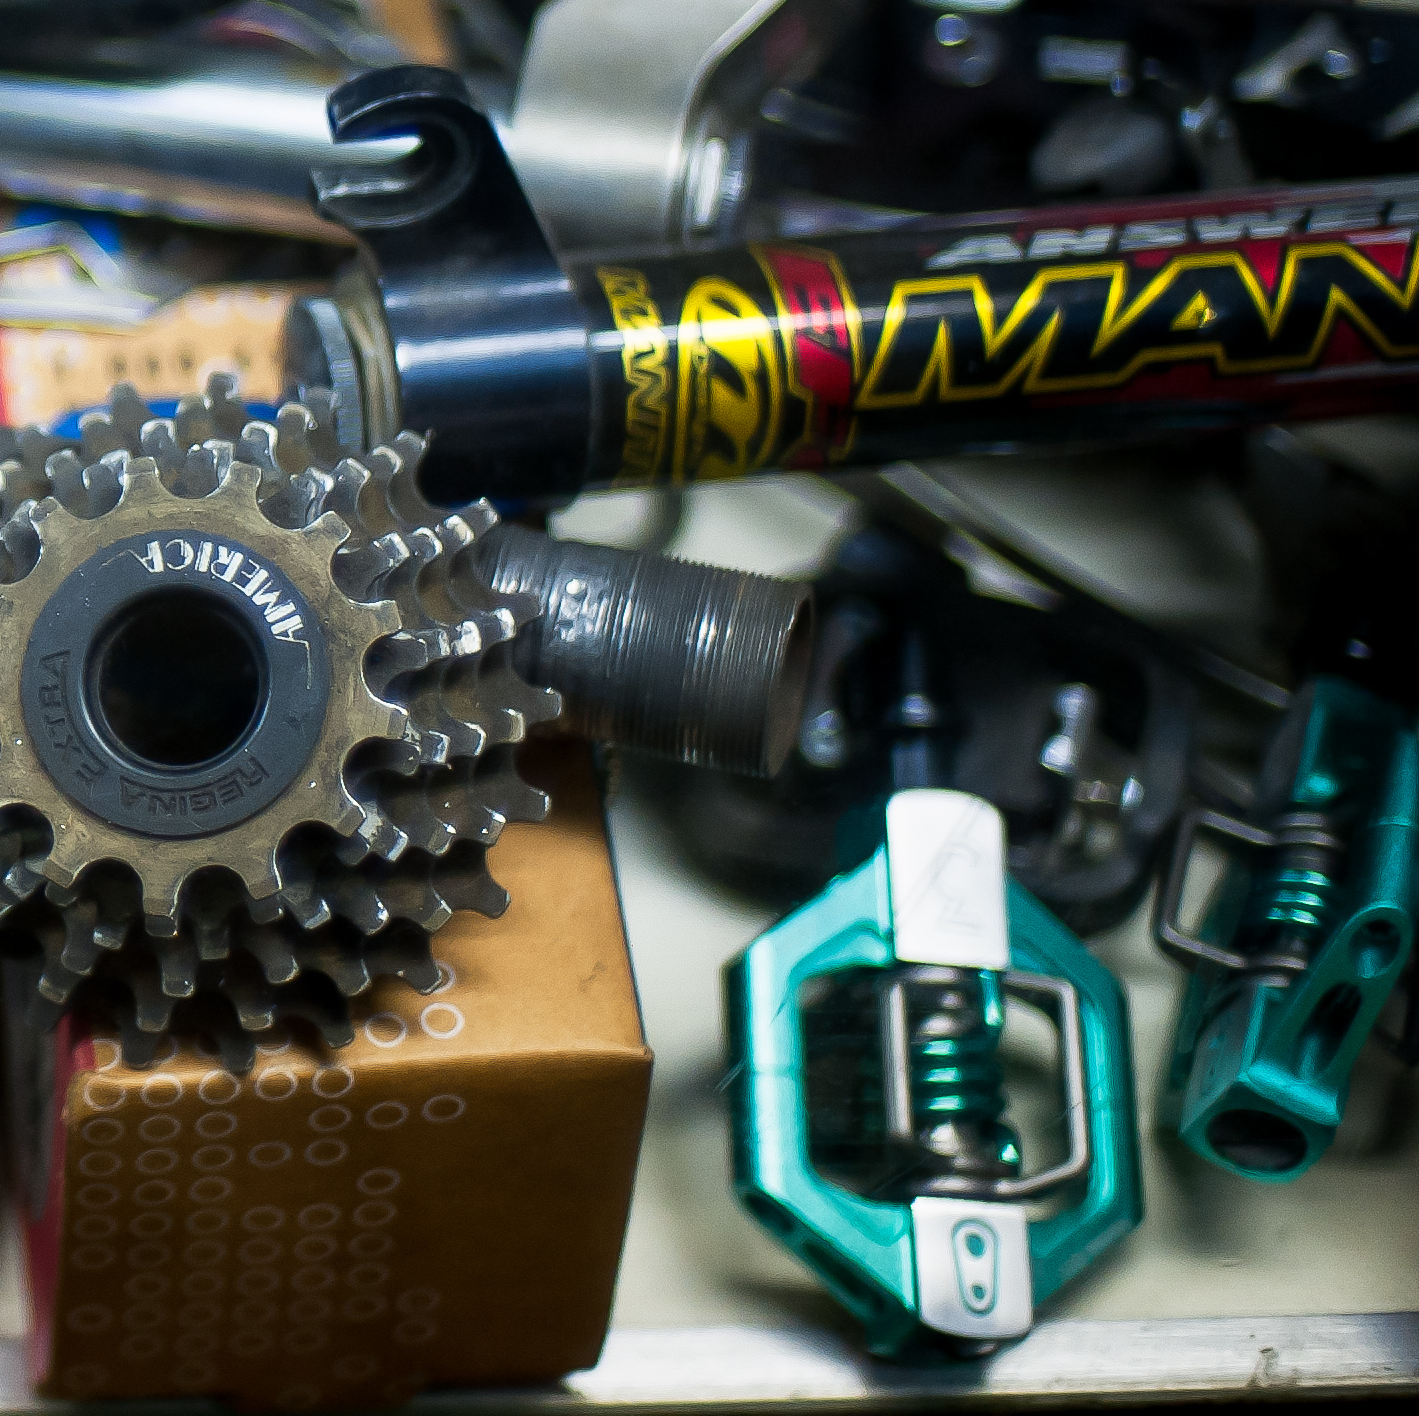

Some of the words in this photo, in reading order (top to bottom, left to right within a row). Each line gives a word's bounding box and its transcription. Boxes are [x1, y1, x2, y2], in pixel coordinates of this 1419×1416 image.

[129, 538, 307, 645] AMERICA
[38, 650, 109, 794] EXTRA
[119, 756, 269, 817] REGINA
